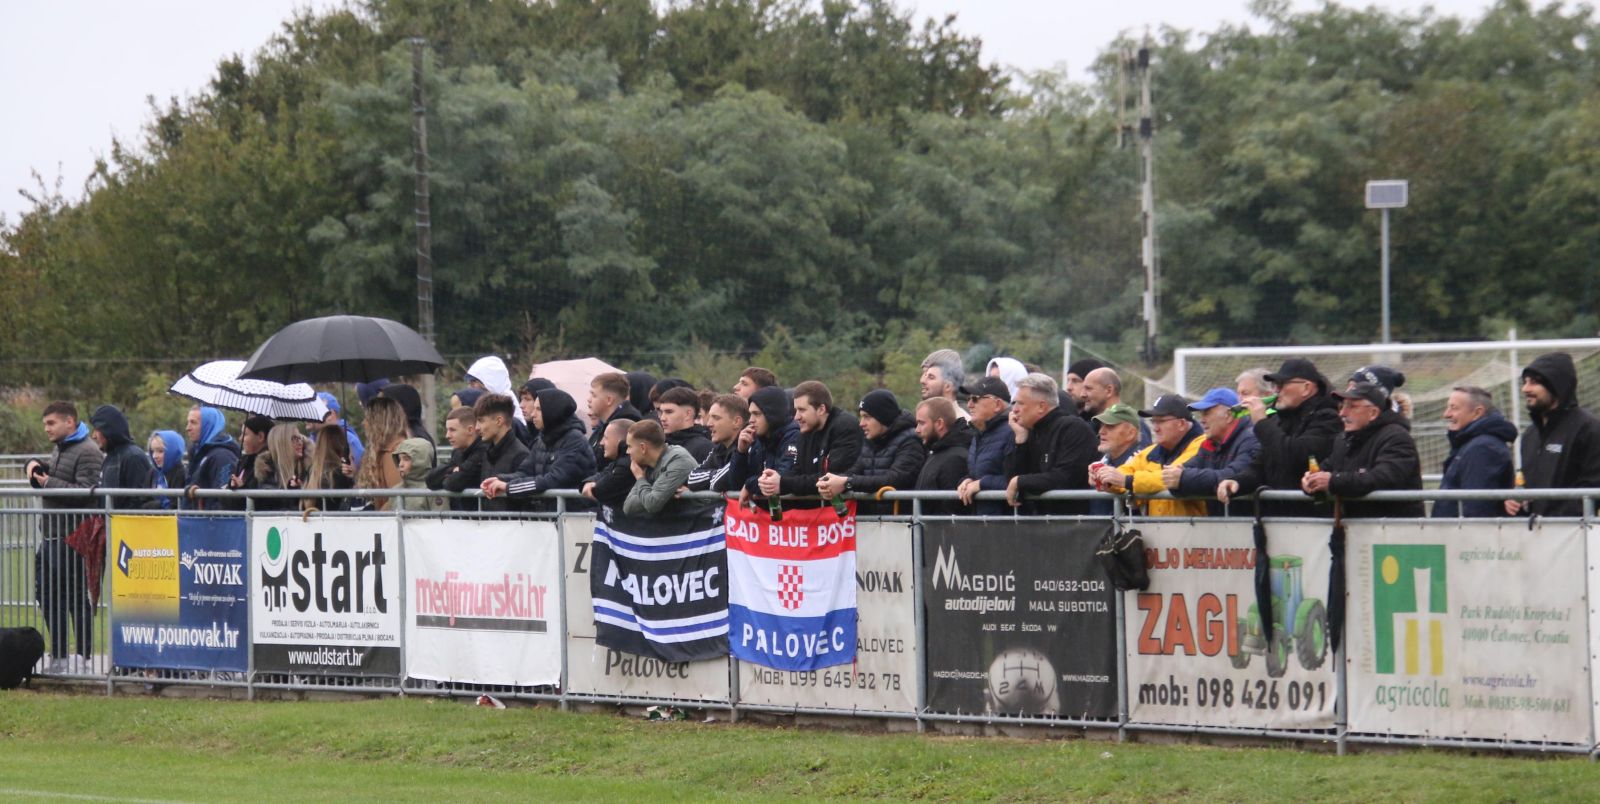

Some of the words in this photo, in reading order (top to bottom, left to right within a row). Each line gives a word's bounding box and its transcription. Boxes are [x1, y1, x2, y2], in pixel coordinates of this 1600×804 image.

[769, 525, 809, 548] BLUE
[817, 517, 855, 546] BOYS
[132, 549, 151, 557] AUTO
[151, 547, 175, 558] ŠKOLA
[1144, 548, 1180, 569] OLJO
[193, 563, 243, 585] NOVAK
[291, 533, 387, 614] start
[932, 545, 1016, 592] MAGDIĆ
[856, 570, 903, 593] NOVAK
[1034, 579, 1106, 592] 040/632-004
[415, 571, 547, 627] medjimurski.hr
[944, 595, 1016, 615] autodijelovi
[1029, 600, 1056, 612] MALA
[1058, 601, 1109, 613] SUBOTICA
[981, 623, 997, 631] AUDI
[1000, 624, 1016, 632] SEAT
[1021, 622, 1042, 632] ŠKODA
[1047, 624, 1057, 632] VW
[1137, 592, 1240, 657] ZAGI
[121, 621, 239, 653] www.pounovak.hr
[742, 622, 845, 658] PALOVEC
[857, 639, 904, 654] ALOVEC
[288, 647, 364, 666] www.oldstart.hr
[823, 671, 852, 688] 645
[858, 672, 876, 690] 32
[882, 673, 901, 691] 78
[1139, 675, 1188, 706] mob:
[1197, 678, 1234, 707] 098
[1241, 679, 1280, 710] 426
[1288, 680, 1326, 711] 091
[1375, 681, 1450, 713] agricola
